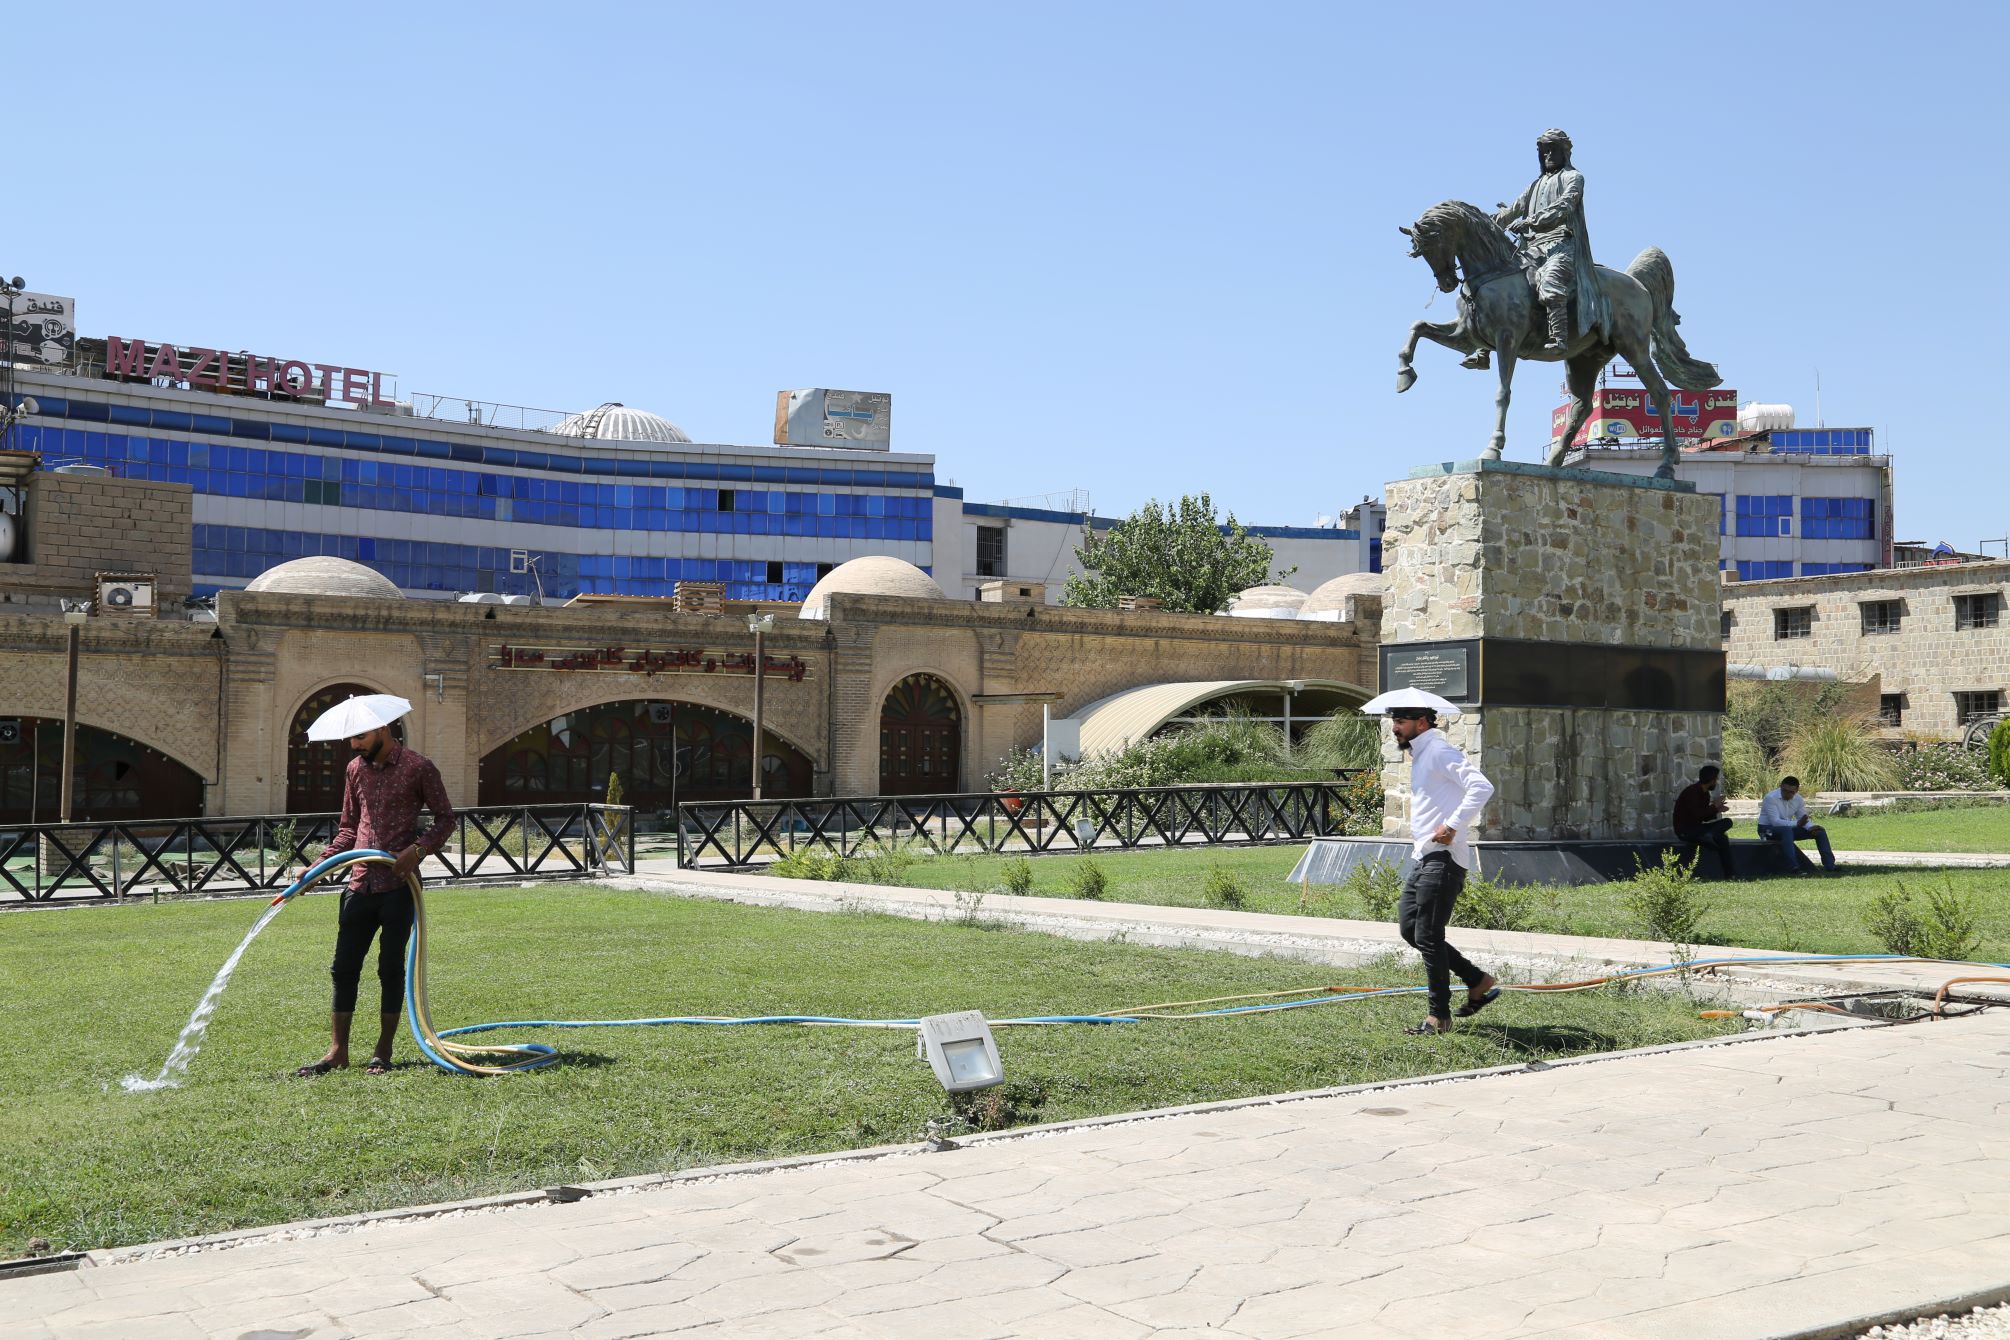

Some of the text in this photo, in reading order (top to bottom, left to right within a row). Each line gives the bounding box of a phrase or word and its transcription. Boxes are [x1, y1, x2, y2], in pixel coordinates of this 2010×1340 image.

[107, 335, 396, 407] MAZI HOTEL
[1645, 393, 1699, 425] پاا
[1639, 425, 1664, 434] لعوائل
